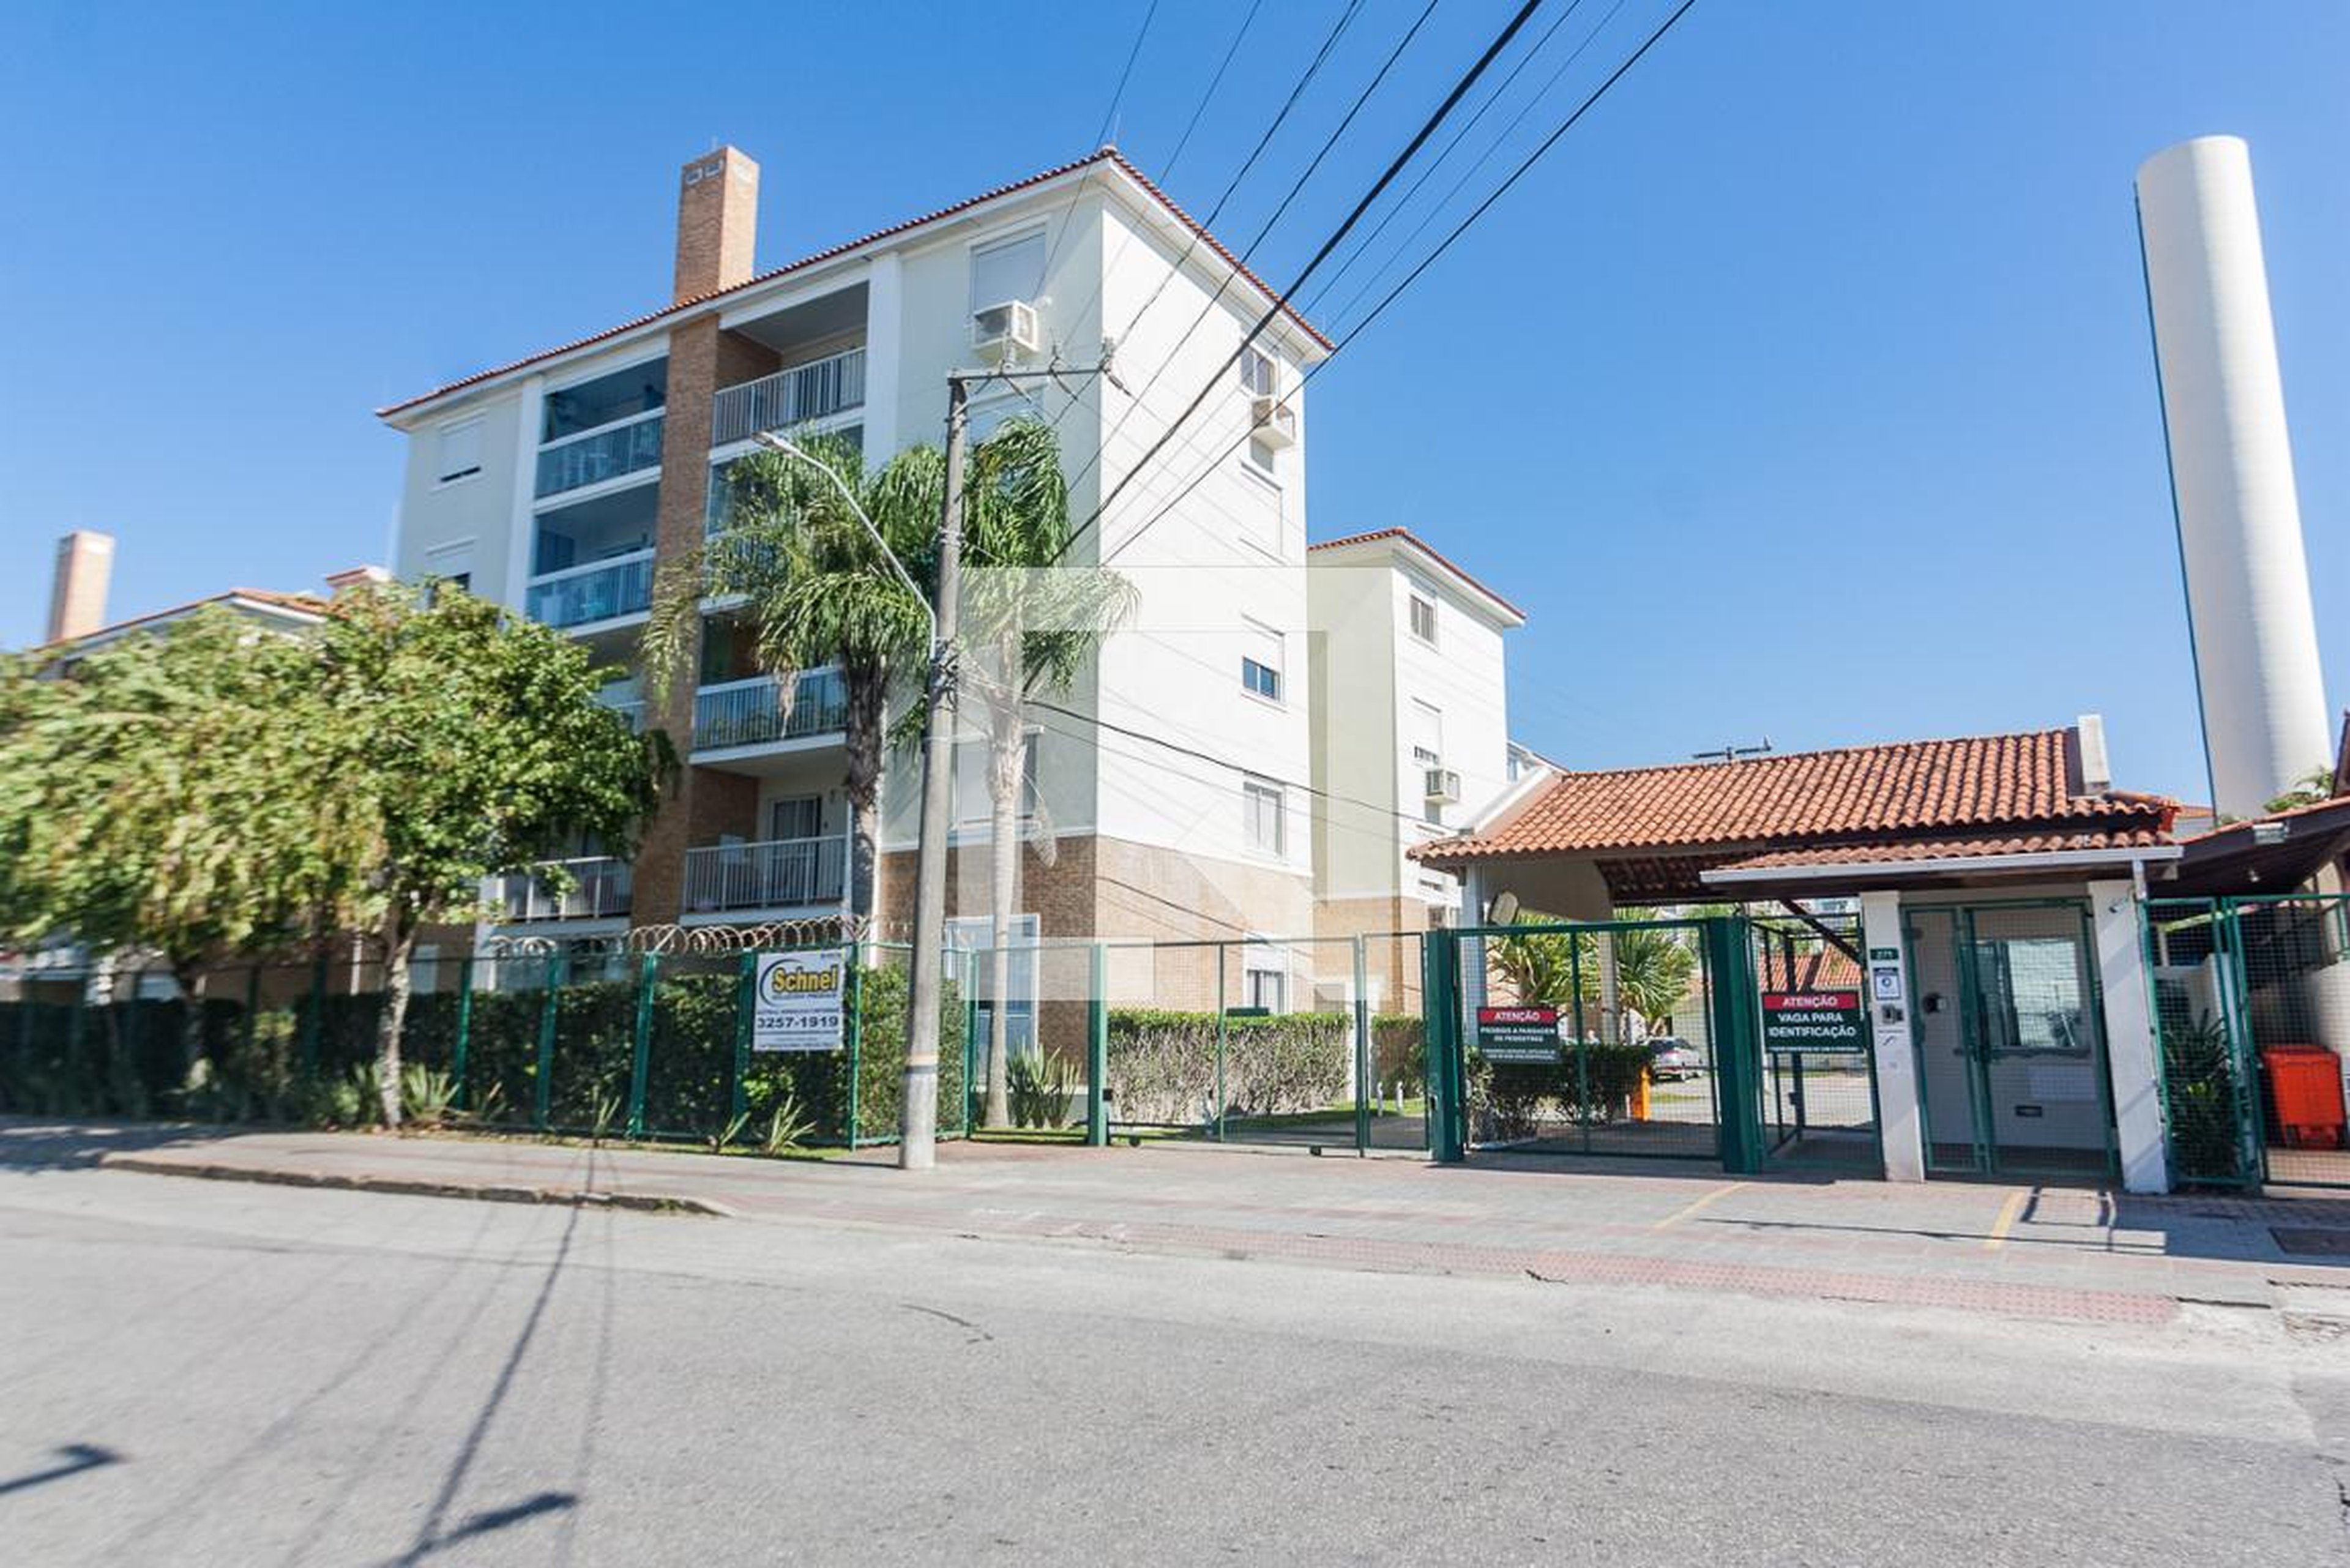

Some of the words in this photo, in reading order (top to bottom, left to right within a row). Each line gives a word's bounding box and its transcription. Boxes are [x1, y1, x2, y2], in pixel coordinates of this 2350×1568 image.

[772, 964, 838, 993] Schnel
[1783, 995, 1838, 1007] ATENÇÃO
[1494, 1010, 1540, 1022] ATENÇÃO
[1778, 1013, 1810, 1022] VAGA
[1811, 1013, 1843, 1021] PARA
[758, 1017, 838, 1028] 3257-1919
[1768, 1026, 1856, 1038] IDENTIFICAÇÃO
